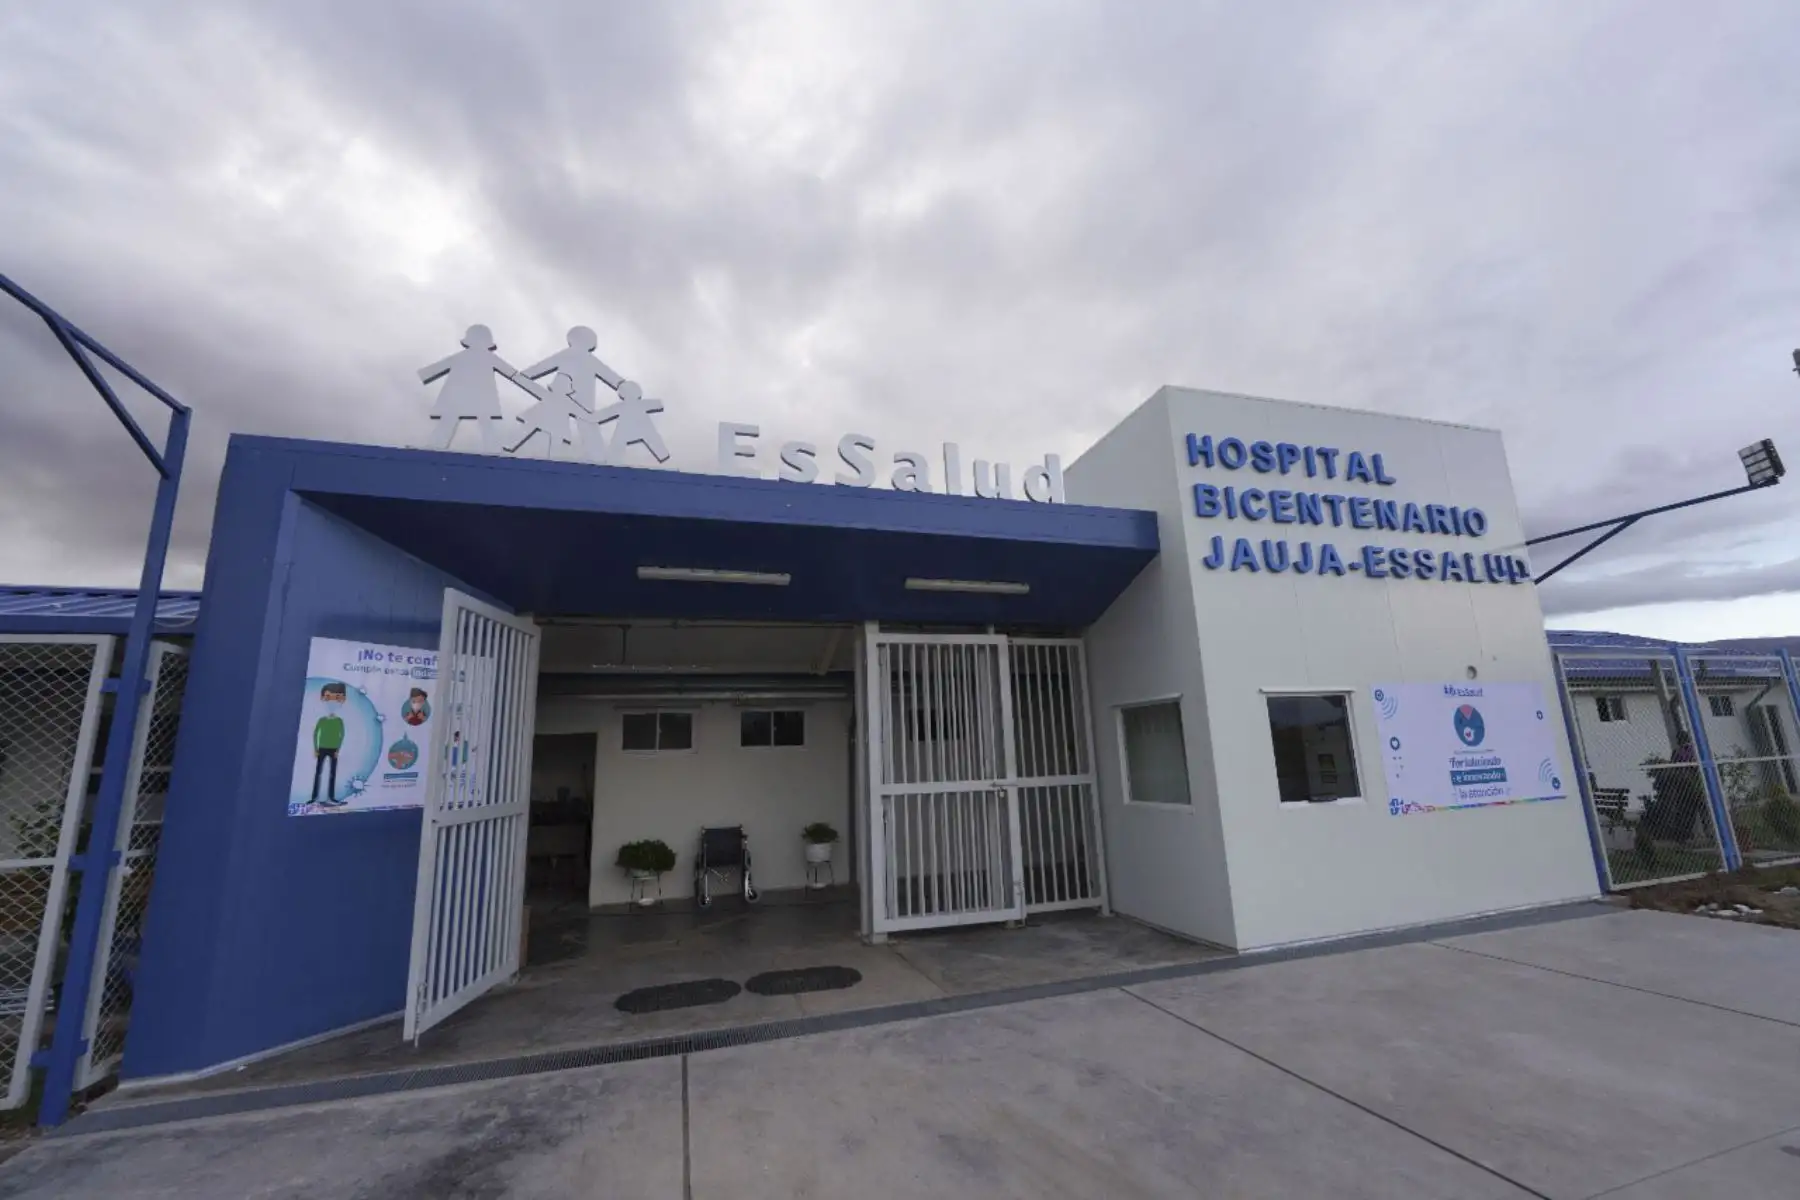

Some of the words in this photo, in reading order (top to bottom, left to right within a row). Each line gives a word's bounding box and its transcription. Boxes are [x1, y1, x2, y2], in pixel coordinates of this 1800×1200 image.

[717, 421, 1065, 503] EsSalud
[1186, 432, 1396, 485] HOSPITAL
[1193, 482, 1488, 537] BICENTENARIO
[1203, 535, 1532, 585] JAUJA-ESSALUD
[388, 652, 403, 663] te
[407, 655, 439, 666] conf
